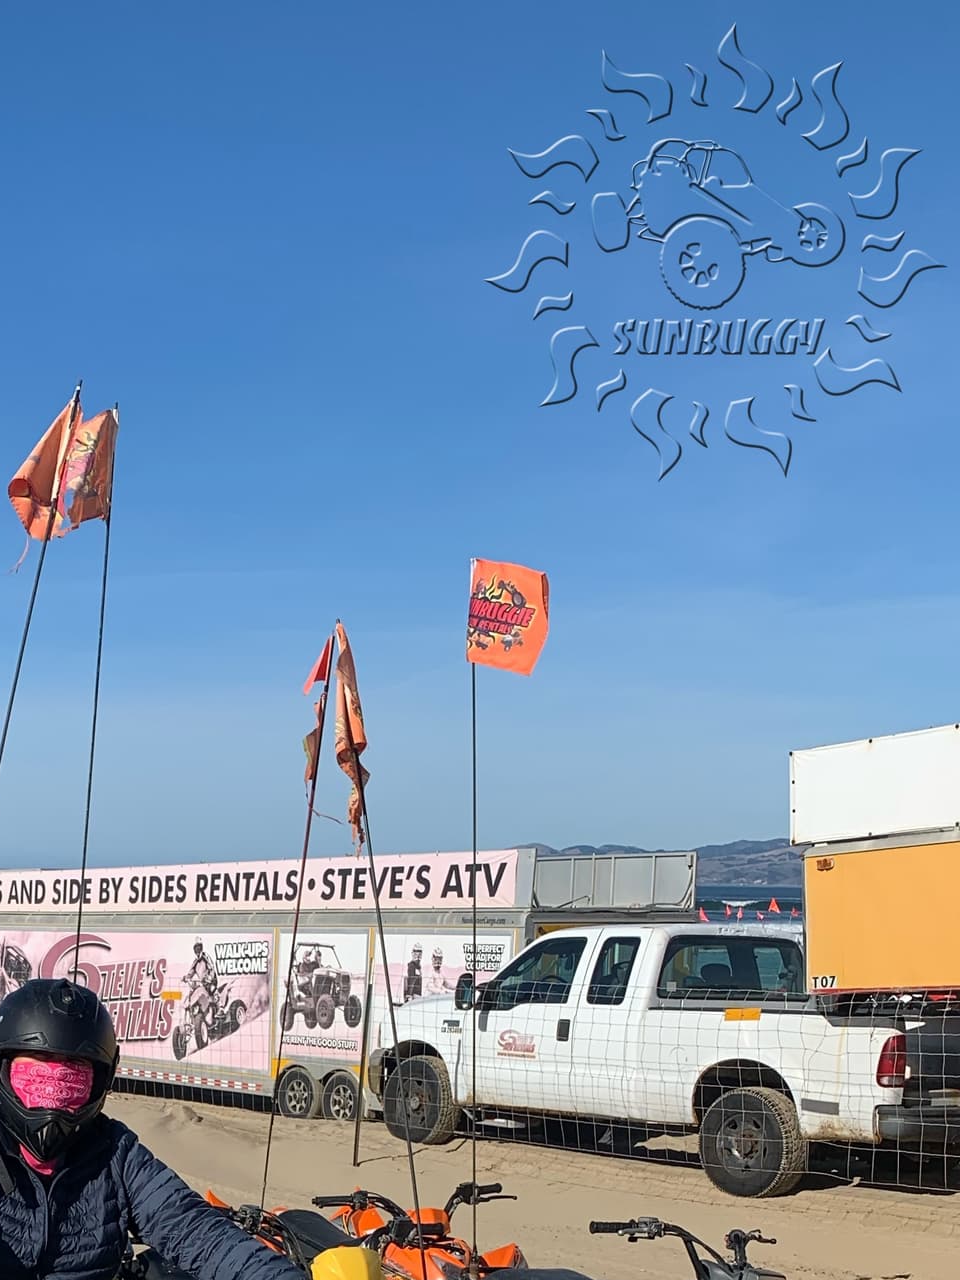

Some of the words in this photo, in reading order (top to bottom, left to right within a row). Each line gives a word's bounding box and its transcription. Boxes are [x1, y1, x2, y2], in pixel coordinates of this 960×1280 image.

[8, 879, 46, 905] AND
[52, 878, 93, 905] SIDE
[99, 877, 124, 904] BY
[129, 874, 187, 904] SIDES
[195, 869, 299, 902] RENTALS
[321, 865, 431, 900] STEVE'S
[441, 862, 508, 899] ATV
[215, 941, 269, 959] WALK-UPS
[463, 945, 477, 953] TH
[216, 957, 268, 974] WELCOME
[108, 999, 175, 1040] ENTALS
[317, 1038, 337, 1047] GOOD
